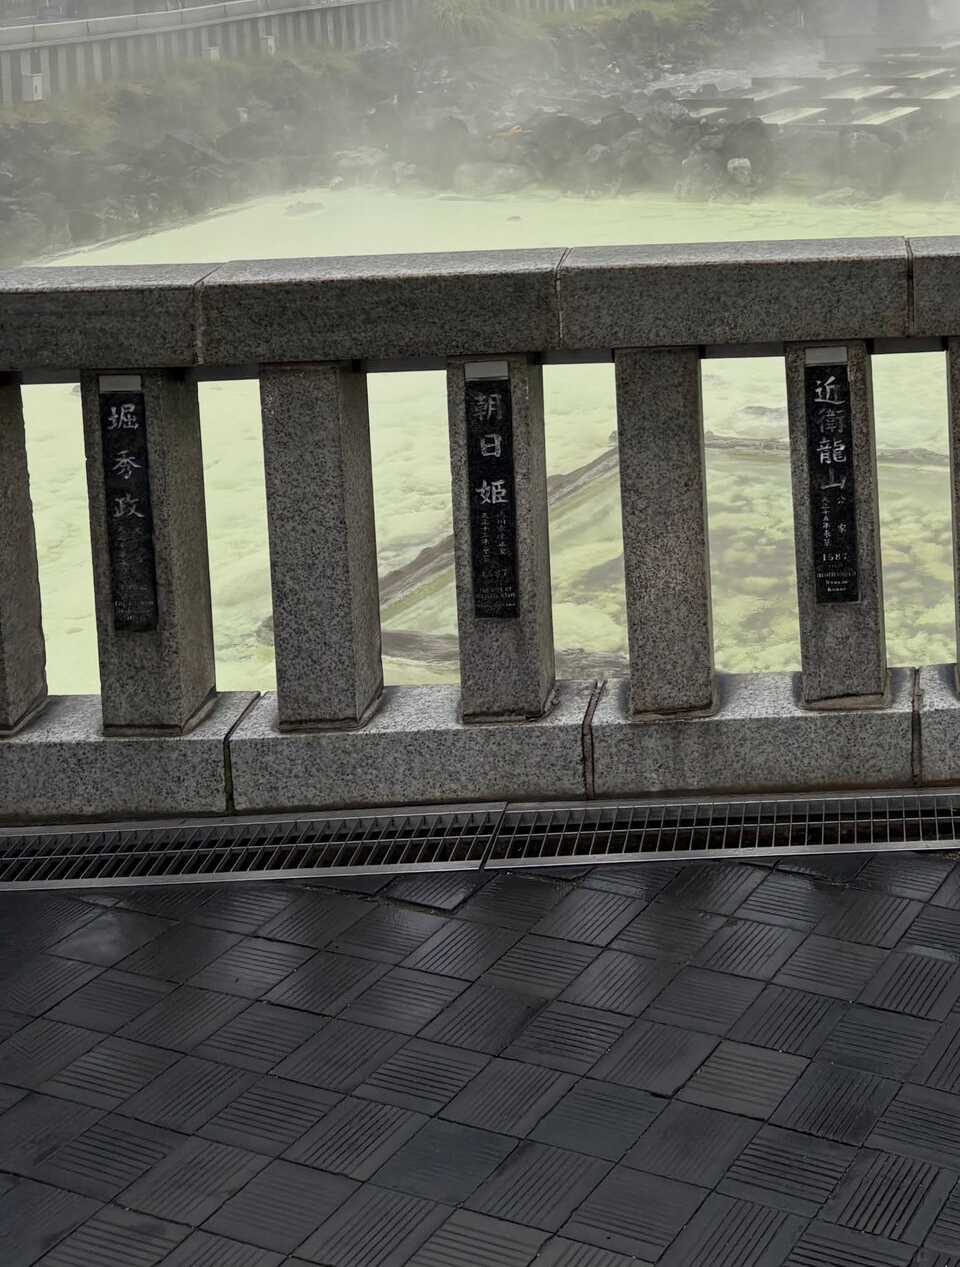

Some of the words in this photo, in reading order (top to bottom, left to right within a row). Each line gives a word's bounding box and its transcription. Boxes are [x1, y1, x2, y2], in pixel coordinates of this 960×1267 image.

[107, 403, 145, 520] 堀秀政
[471, 392, 510, 506] 朝日姫
[814, 375, 847, 490] 近衛龍山
